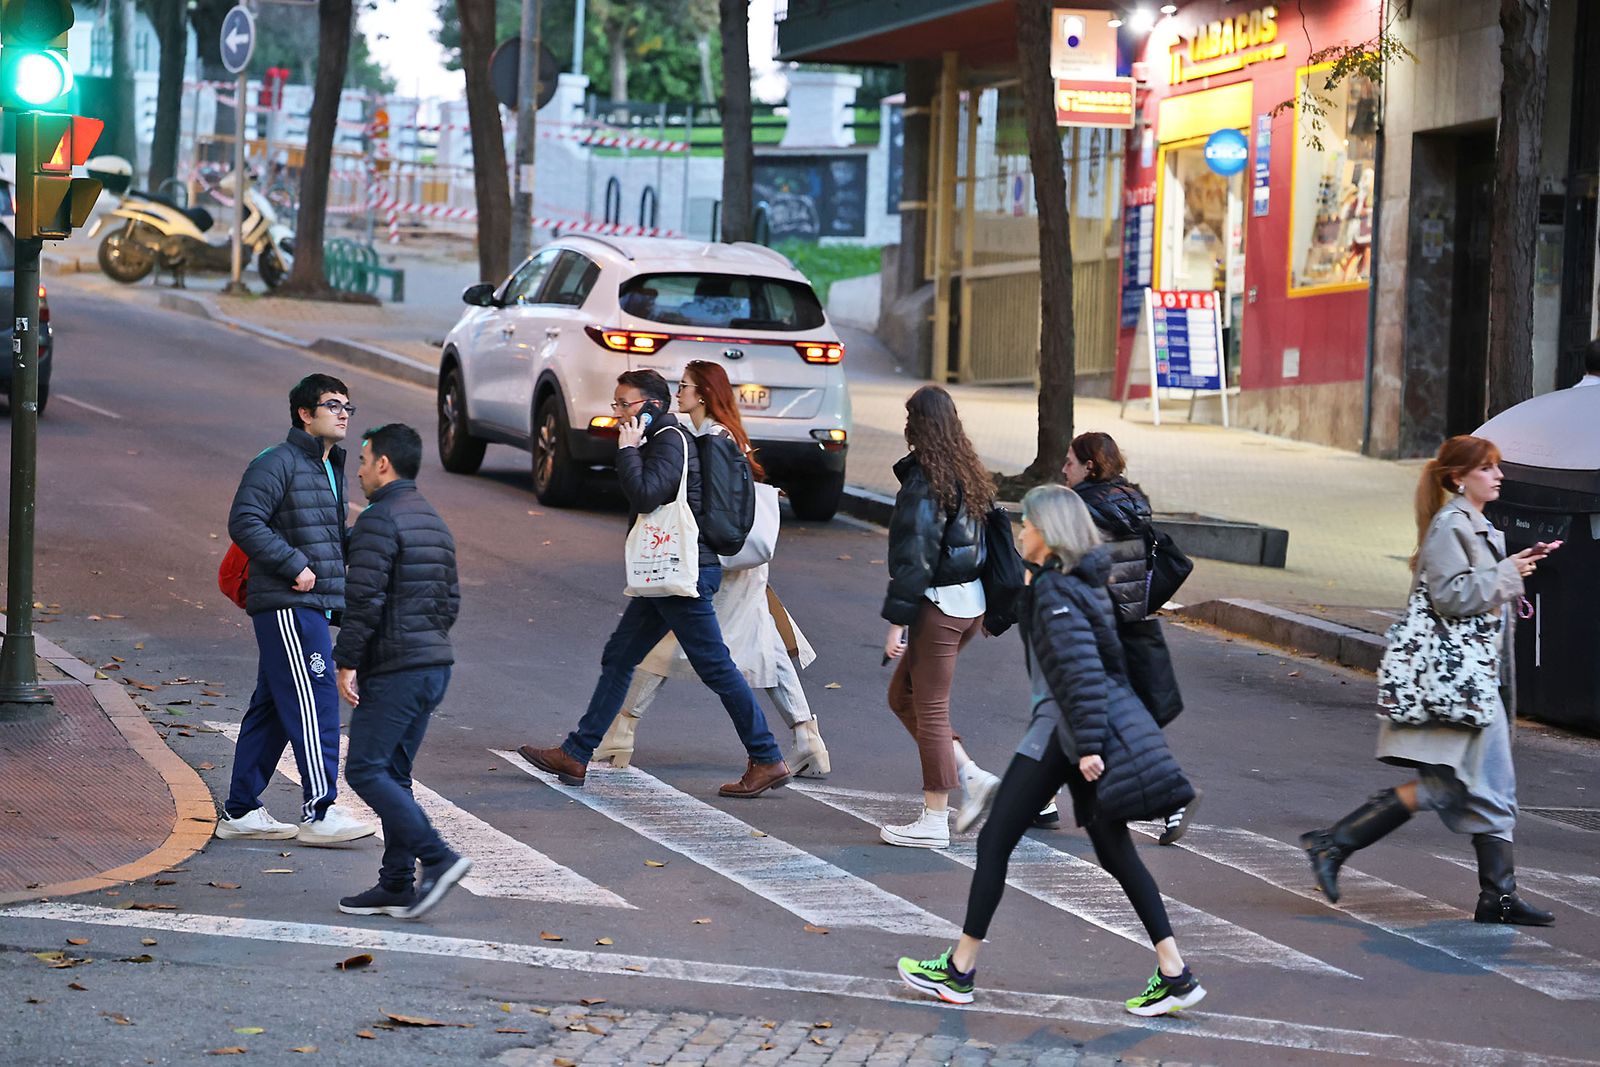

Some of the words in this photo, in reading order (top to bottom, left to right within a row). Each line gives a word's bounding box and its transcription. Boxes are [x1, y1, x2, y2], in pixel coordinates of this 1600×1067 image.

[1188, 6, 1278, 62] TABACOS
[1152, 292, 1214, 309] BOTES
[739, 389, 766, 404] KTP
